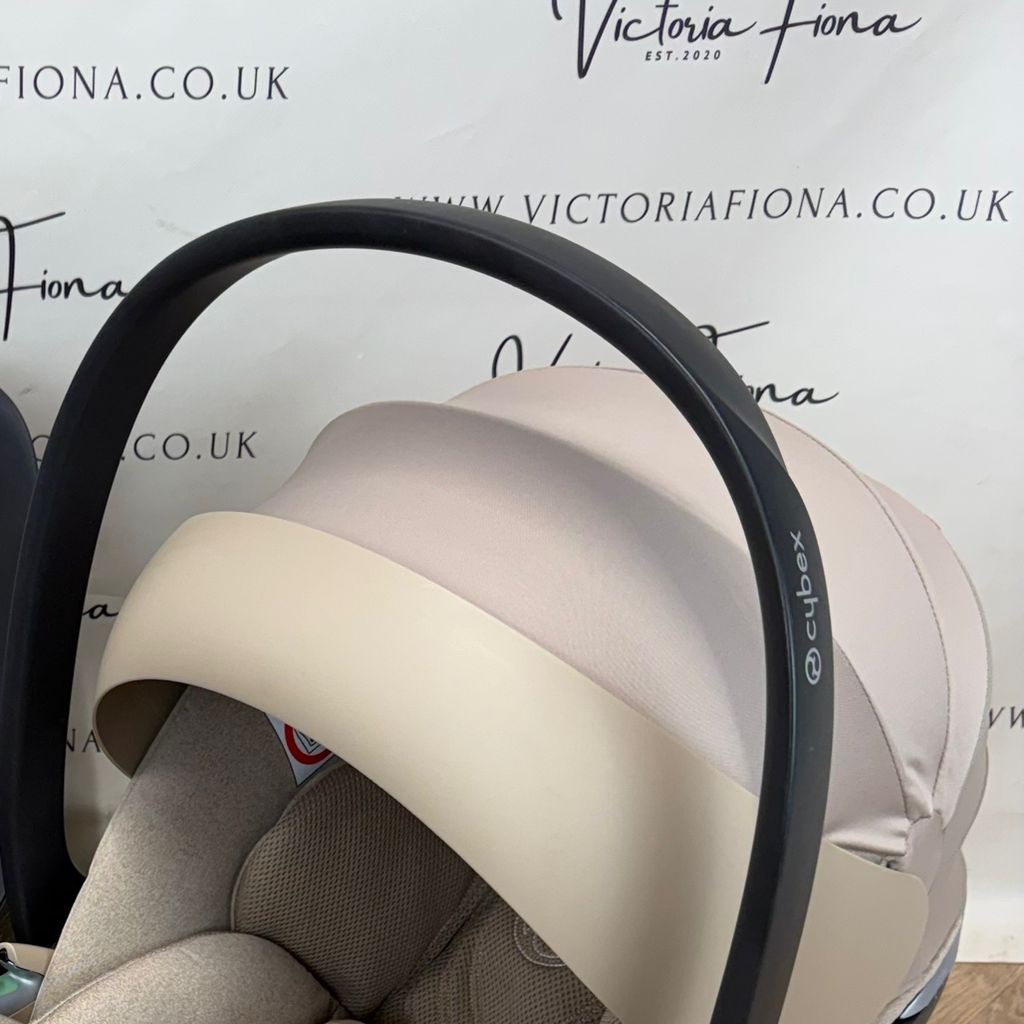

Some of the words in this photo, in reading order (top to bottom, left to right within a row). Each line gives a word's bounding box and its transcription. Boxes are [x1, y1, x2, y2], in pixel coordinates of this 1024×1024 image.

[551, 0, 757, 79] Victoria
[645, 49, 721, 62] EST.2020
[789, 530, 819, 641] cybex
